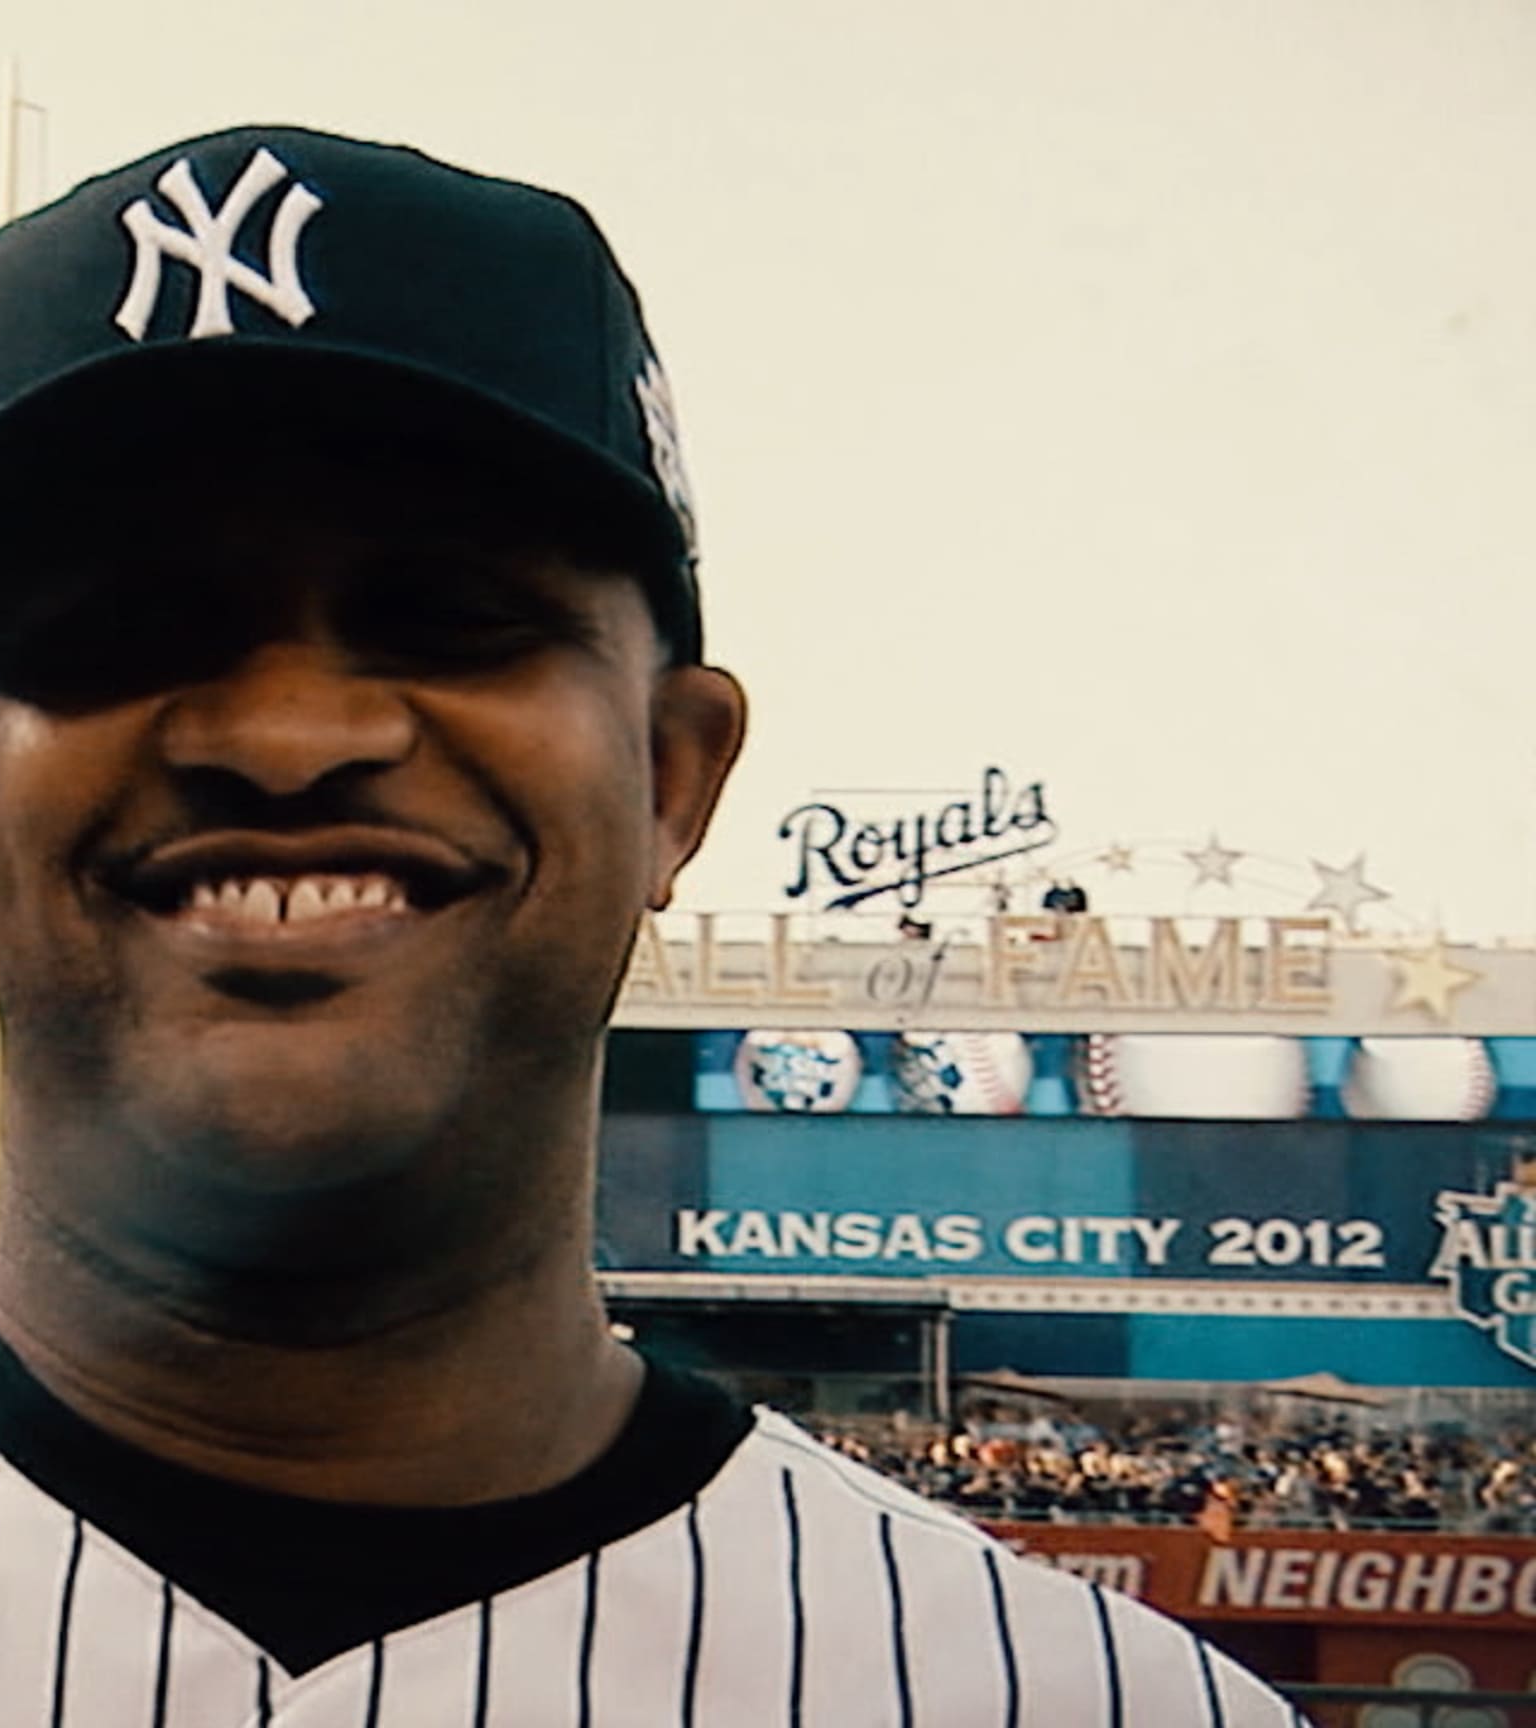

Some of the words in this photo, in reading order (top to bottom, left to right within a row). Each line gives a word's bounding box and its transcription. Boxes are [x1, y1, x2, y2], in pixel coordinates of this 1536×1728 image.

[115, 147, 323, 341] NY
[778, 766, 1056, 908] Royals
[622, 912, 836, 1004] ALL
[866, 928, 972, 1022] of
[984, 915, 1332, 1007] FAME
[677, 1209, 983, 1261] KANSAS
[1005, 1216, 1181, 1265] CITY
[1208, 1217, 1386, 1267] 2012
